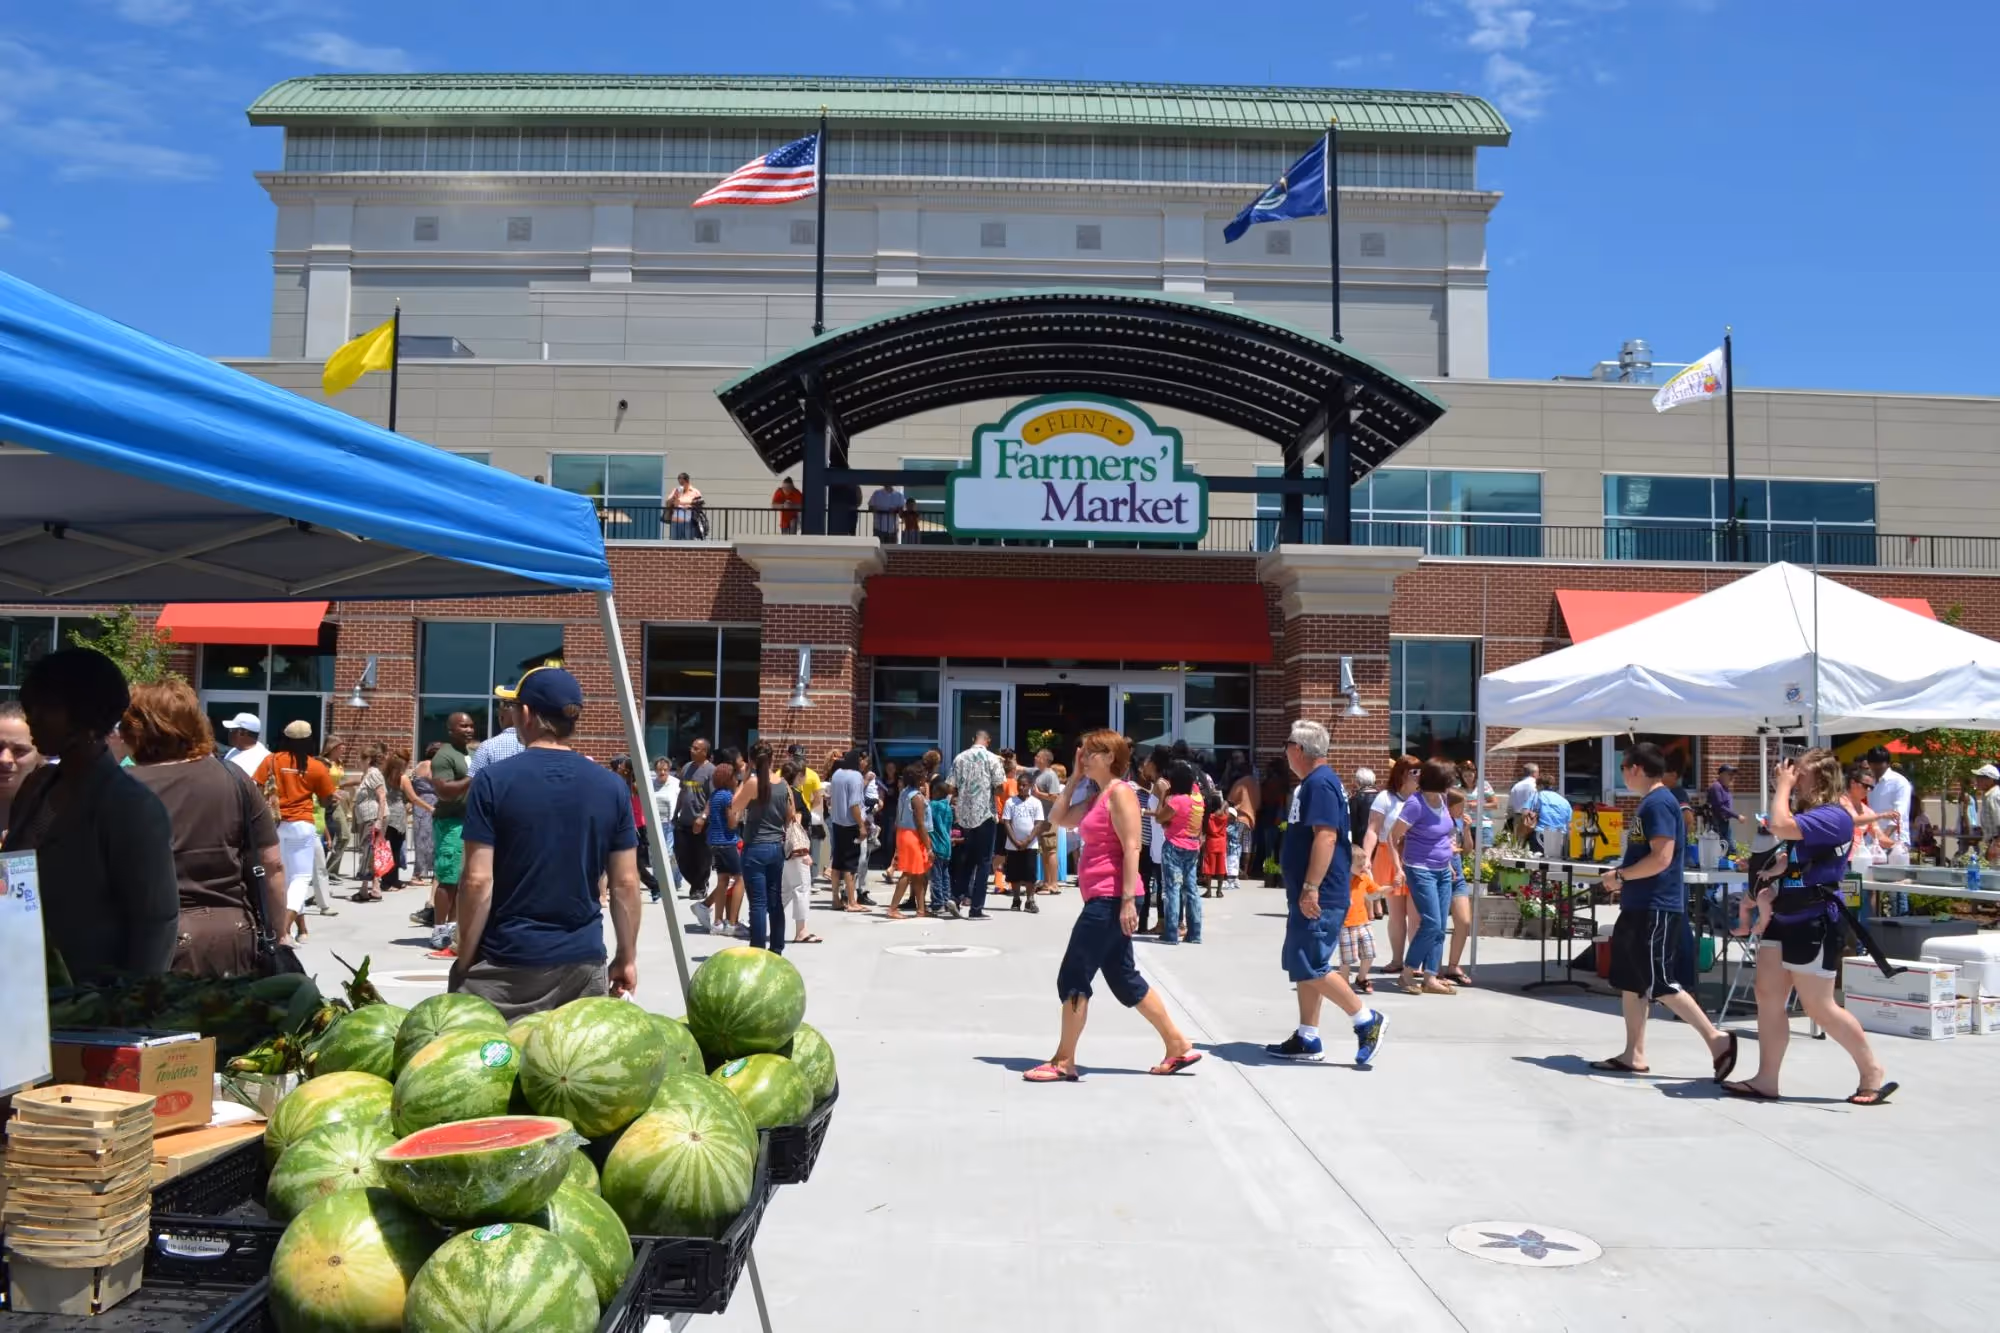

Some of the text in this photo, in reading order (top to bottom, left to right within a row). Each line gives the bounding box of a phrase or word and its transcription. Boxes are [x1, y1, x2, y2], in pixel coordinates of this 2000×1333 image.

[1046, 413, 1112, 432] FLINT
[994, 439, 1168, 482] Farmers'
[1041, 481, 1189, 524] Market
